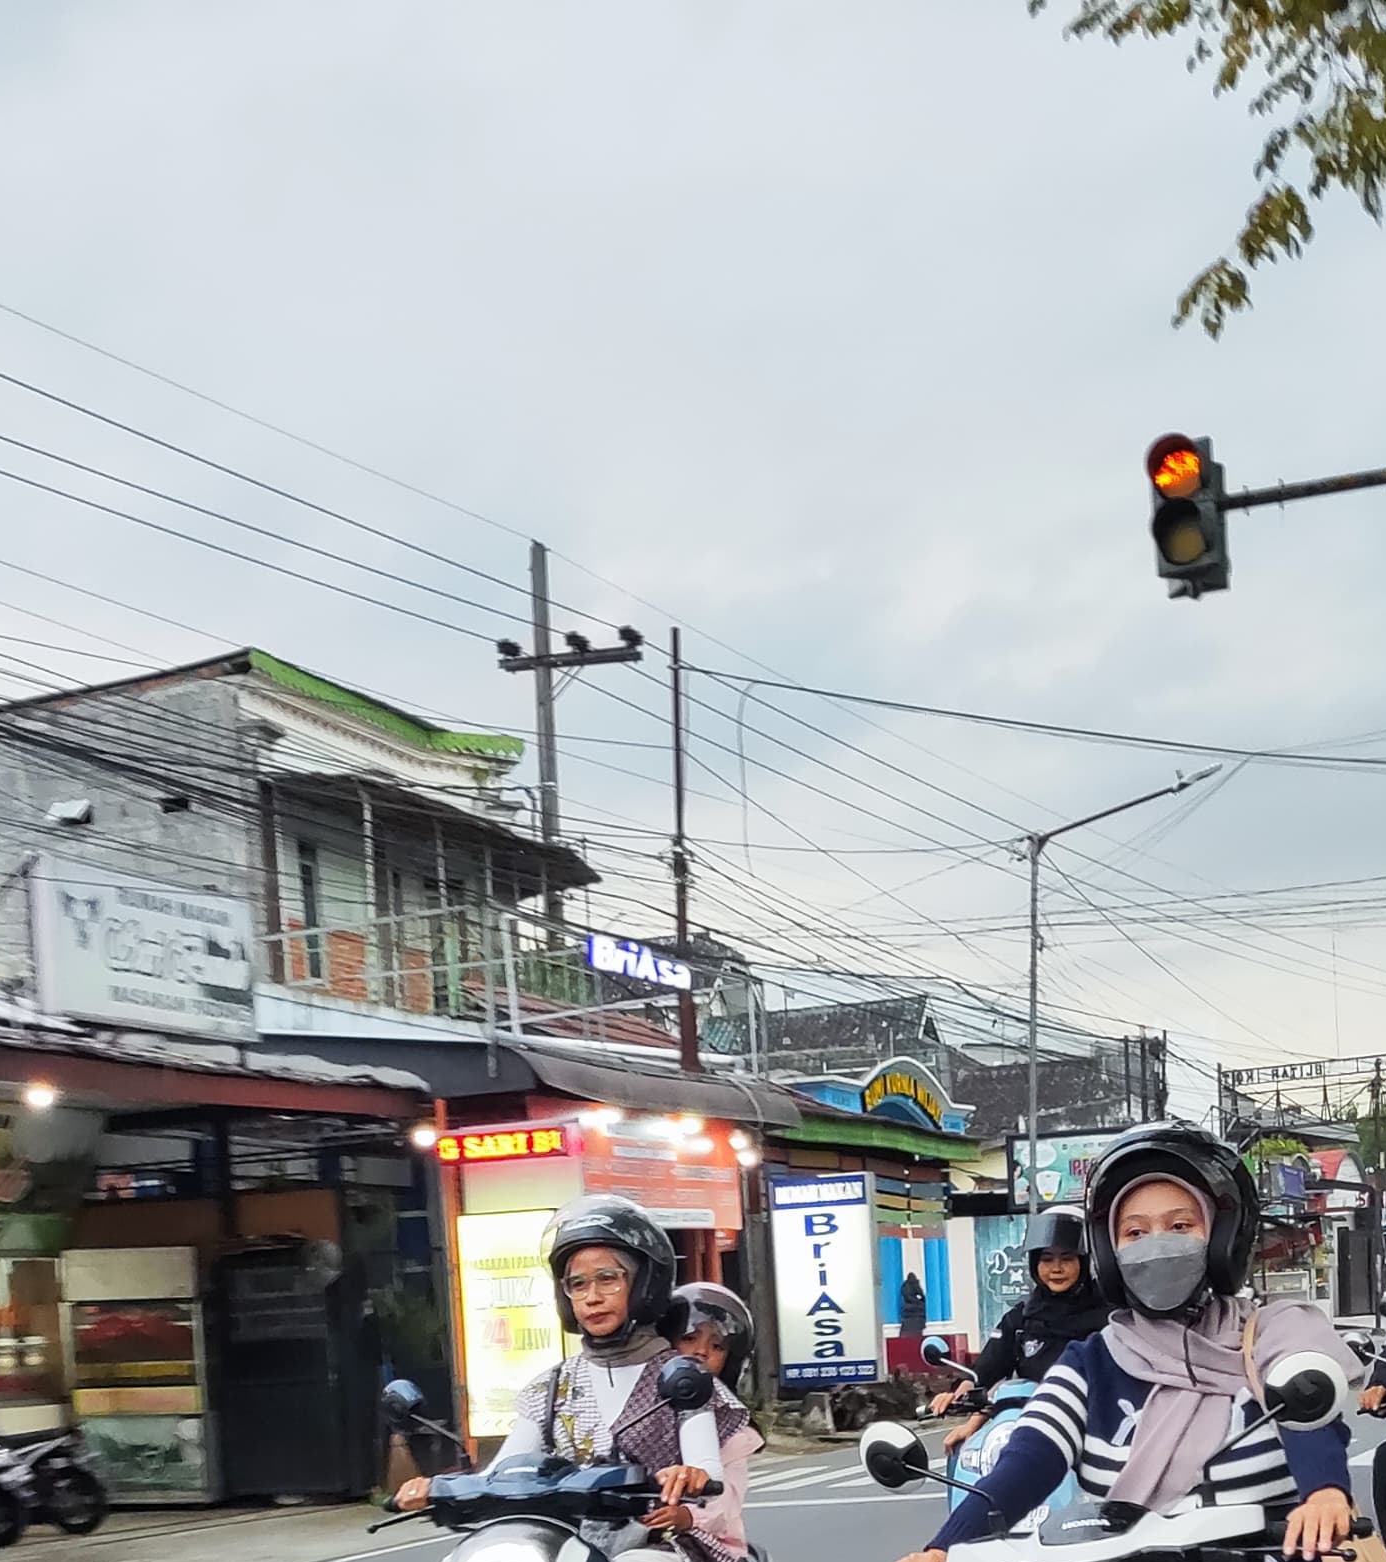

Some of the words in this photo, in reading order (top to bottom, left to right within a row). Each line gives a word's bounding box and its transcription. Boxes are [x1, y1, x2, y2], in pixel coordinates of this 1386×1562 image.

[587, 932, 692, 991] BriAsa
[463, 1131, 530, 1159] SARI
[804, 1213, 846, 1359] BriAsa
[1061, 1518, 1111, 1530] HONDA
